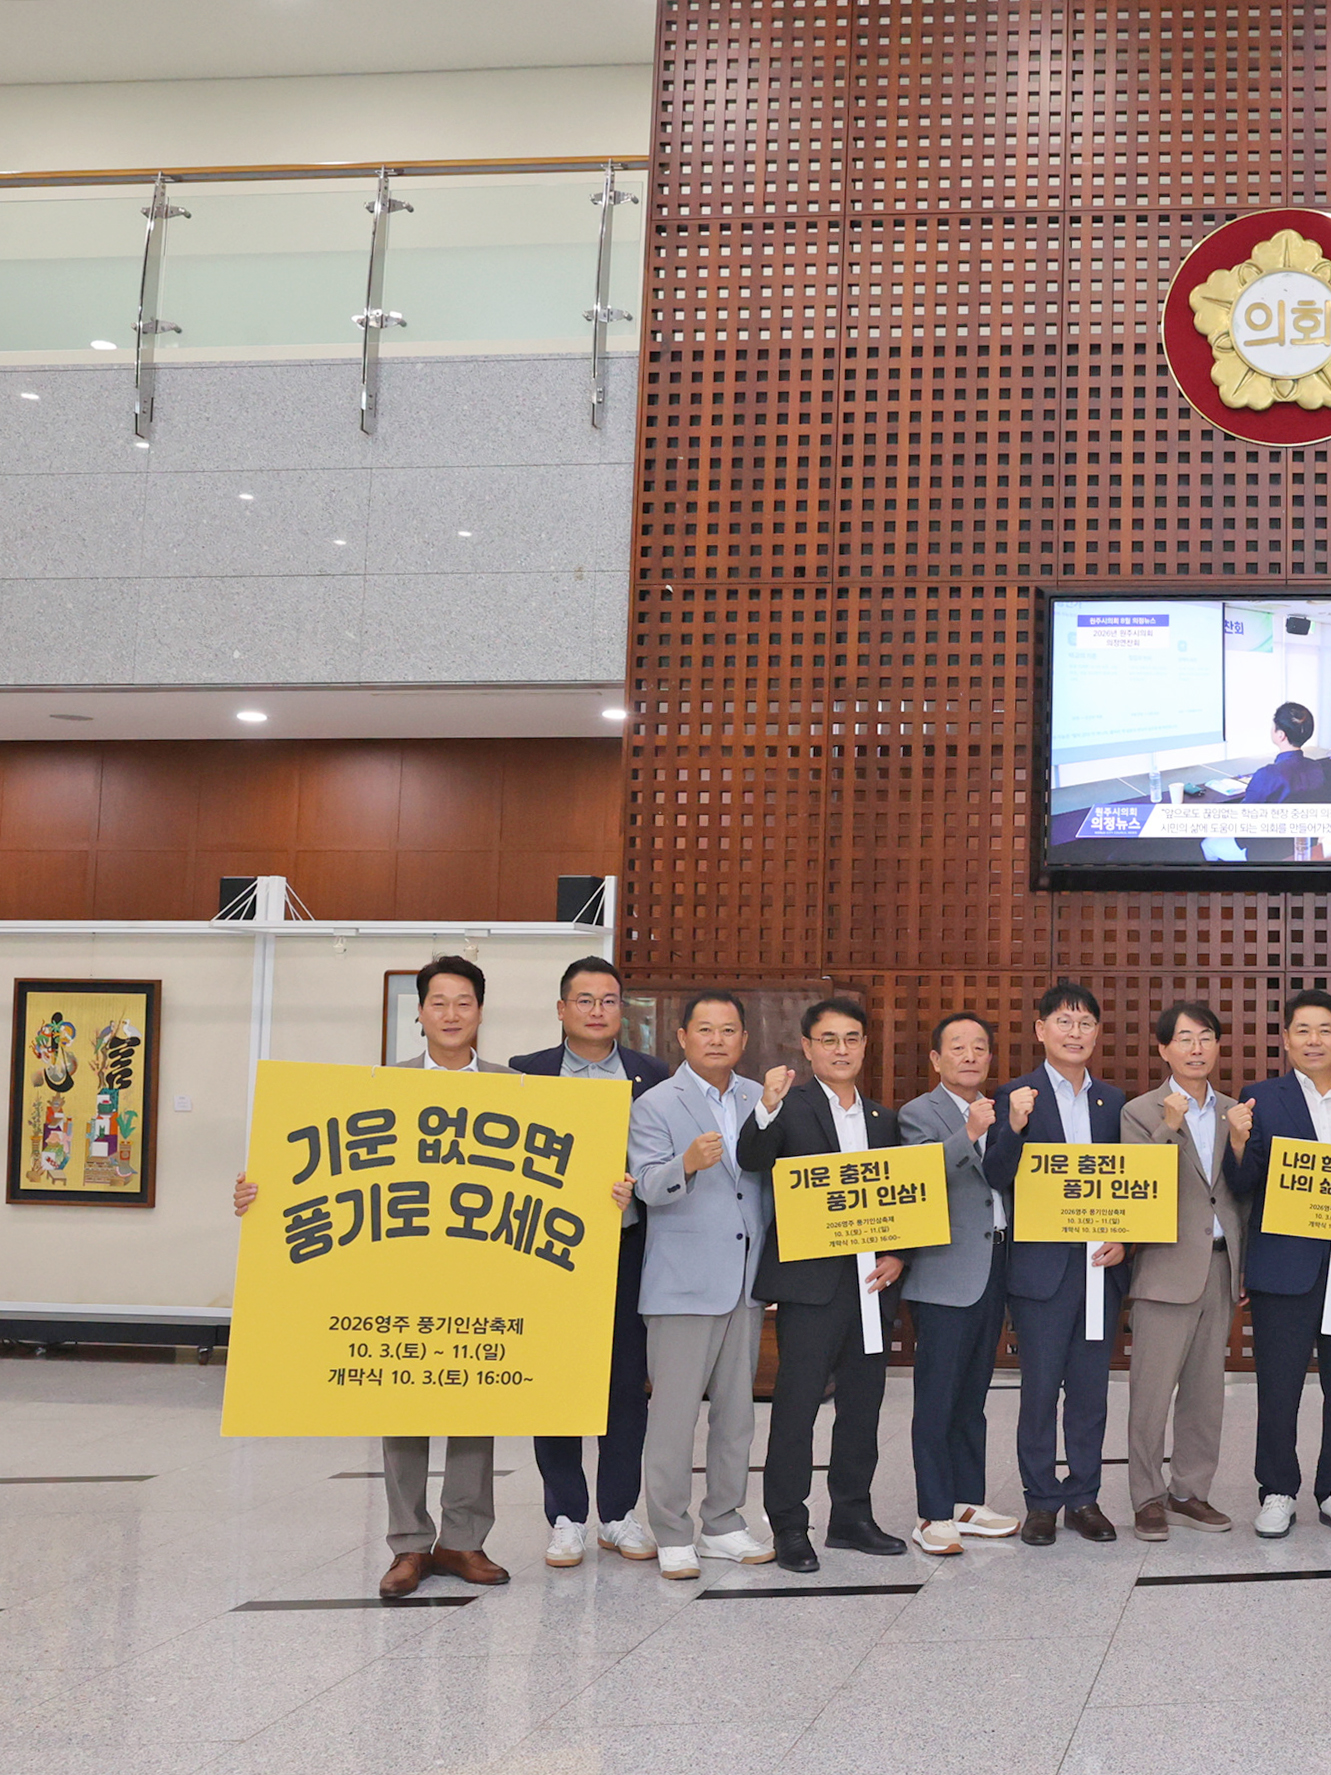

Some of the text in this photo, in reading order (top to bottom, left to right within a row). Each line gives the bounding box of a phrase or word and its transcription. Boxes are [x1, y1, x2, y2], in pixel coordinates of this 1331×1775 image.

[1244, 300, 1331, 346] 의회
[1090, 617, 1119, 625] 원주시의회
[1093, 629, 1153, 637] 2026년 원주시의회
[1095, 807, 1137, 816] 원주시의회
[1241, 809, 1268, 818] 학습과
[1271, 809, 1288, 819] 현장
[1291, 809, 1317, 819] 중심의
[1091, 817, 1141, 830] 의정뉴스
[1161, 823, 1187, 833] 시민의
[1190, 823, 1208, 833] 삶에
[1211, 823, 1237, 833] 도움이
[1240, 824, 1257, 833] 되는
[1261, 823, 1286, 833] 의회를
[287, 1106, 575, 1189] 기운 없으면
[1031, 1154, 1125, 1174] 기운 충전!
[1282, 1152, 1316, 1170] 나의
[790, 1161, 890, 1189] 기운 충전!
[1280, 1174, 1313, 1192] 나의
[827, 1183, 926, 1212] 풍기 인삼!
[1063, 1179, 1158, 1199] 풍기 인삼!
[283, 1181, 585, 1271] 풍기로 오세요
[826, 1216, 895, 1229] 2026영주 풍기인삼축제
[870, 1226, 890, 1234] 11.(일)
[1308, 1221, 1327, 1229] 개막식
[829, 1240, 848, 1248] 개막식
[862, 1236, 878, 1244] 3.(토)
[880, 1234, 901, 1242] 16:00~
[329, 1316, 524, 1335] 2026영주 풍기인삼축제
[348, 1342, 505, 1360] 10. 3.(토) 11.(일)
[328, 1367, 534, 1387] 개막식 10. 3.(토) 16:00~
